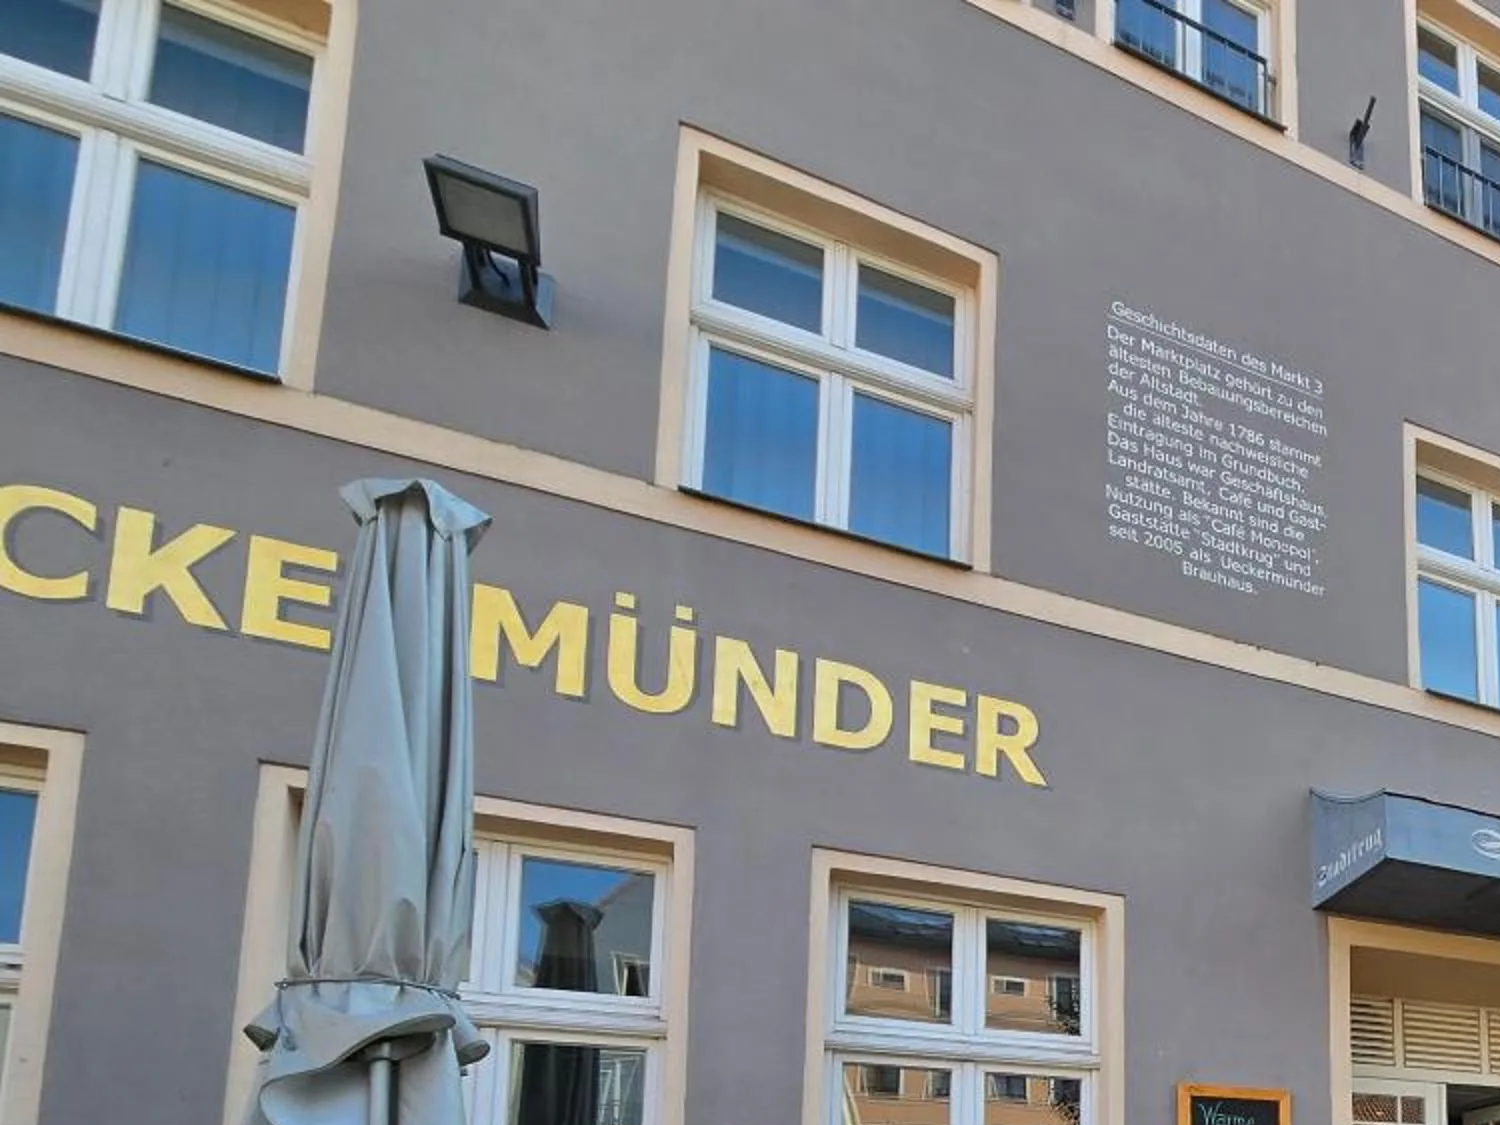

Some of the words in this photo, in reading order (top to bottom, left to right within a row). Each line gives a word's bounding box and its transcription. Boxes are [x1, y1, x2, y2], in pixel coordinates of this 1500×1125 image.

[1111, 301, 1237, 360] Geschichtsdaten
[1241, 353, 1267, 373] des
[1271, 362, 1310, 390] Markt
[1107, 324, 1136, 346] Der
[1141, 338, 1221, 380] Marktplatz
[1277, 393, 1293, 409] zu
[1297, 400, 1323, 419] den
[1108, 361, 1136, 380] der
[1107, 379, 1138, 401] Aus
[1143, 392, 1177, 414] dem
[1123, 402, 1147, 421] die
[1180, 369, 1328, 437] Bebauungsbereichen
[1107, 413, 1193, 457] Eintragung
[1199, 444, 1217, 463] im
[1107, 430, 1139, 453] Das
[1143, 441, 1183, 469] Haus
[1187, 460, 1217, 479] war
[1105, 483, 1174, 520] Nutzung
[1179, 509, 1201, 527] als
[1182, 490, 1245, 523] Bekannt
[1249, 515, 1279, 533] sind
[1257, 500, 1285, 519] und
[1108, 524, 1139, 543] seit
[1143, 531, 1184, 555] 2005
[1189, 547, 1212, 563] als
[1283, 559, 1311, 577] und
